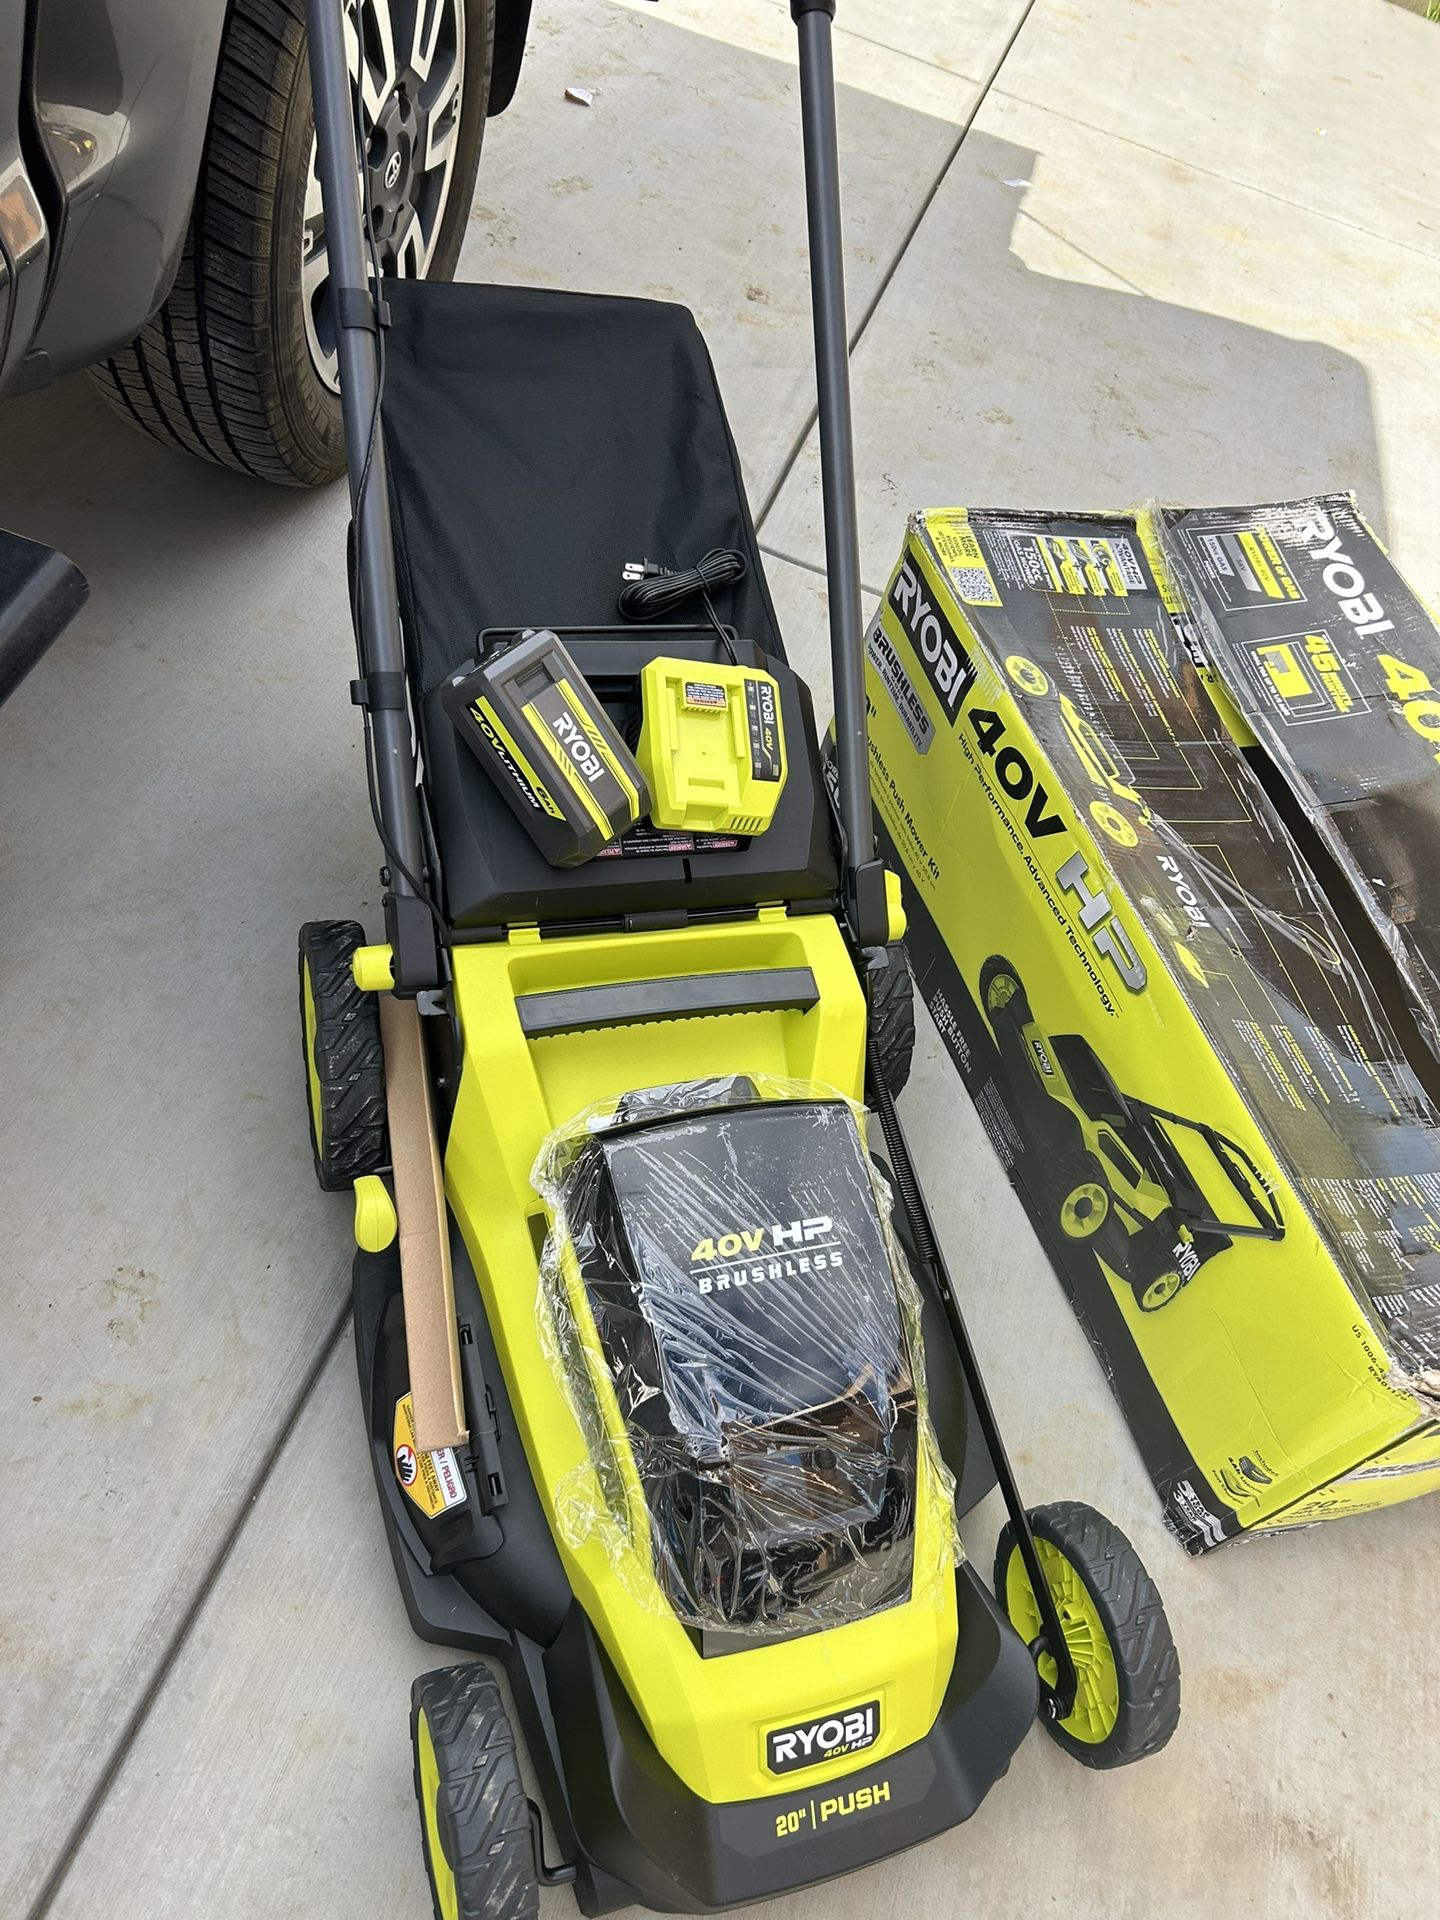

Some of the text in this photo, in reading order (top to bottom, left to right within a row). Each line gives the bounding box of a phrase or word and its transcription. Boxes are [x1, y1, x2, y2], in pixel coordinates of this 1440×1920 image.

[958, 536, 972, 557] MORE
[964, 535, 980, 559] LEARN
[1024, 546, 1044, 581] 150cc
[1114, 543, 1135, 585] ADVANTAGE
[1121, 542, 1142, 584] 40V HP
[1206, 537, 1228, 571] 150cc GAS
[1247, 546, 1262, 568] RYOBI
[1017, 557, 1034, 584] MOWER
[1042, 575, 1054, 589] THAN
[1280, 575, 1300, 599] GAS
[1291, 508, 1394, 640] RYOBI
[891, 559, 967, 708] RYOBI
[1304, 635, 1341, 673] 45
[871, 626, 930, 735] BRUSHLESS
[1263, 677, 1272, 685] UP
[1268, 685, 1276, 694] TO
[760, 685, 775, 751] RYOBI 40V
[1377, 654, 1440, 766] 40
[469, 707, 540, 809] 40V LITHIUM
[552, 711, 606, 783] RYOBI
[536, 786, 555, 814] 6Ah
[866, 735, 891, 782] ushless
[886, 778, 908, 813] Push
[902, 812, 930, 858] Mower
[926, 856, 941, 880] Kit
[955, 732, 978, 767] High
[970, 762, 1026, 856] Performance.
[1020, 854, 1067, 926] Advanced
[967, 710, 1149, 992] 40V HP
[1155, 853, 1212, 931] RYOBI
[927, 1000, 946, 1034] START
[931, 993, 972, 1074] PUSH BUTTON
[935, 988, 972, 1058] HASSLE FREE
[690, 1215, 833, 1262] 40V HP
[698, 1251, 844, 1295] BRUSHLESS
[1171, 1242, 1201, 1281] RYOBI
[1350, 1324, 1362, 1339] US
[426, 1459, 440, 1492] FEET AWAY
[441, 1466, 458, 1499] PELIGRO
[1210, 1468, 1244, 1505] Fast Charger
[1171, 1488, 1184, 1503] 3
[1191, 1494, 1210, 1517] YEAR
[772, 1707, 875, 1763] RYOBI
[823, 1736, 873, 1758] 40V HP
[775, 1781, 891, 1837] 20" PUSH
